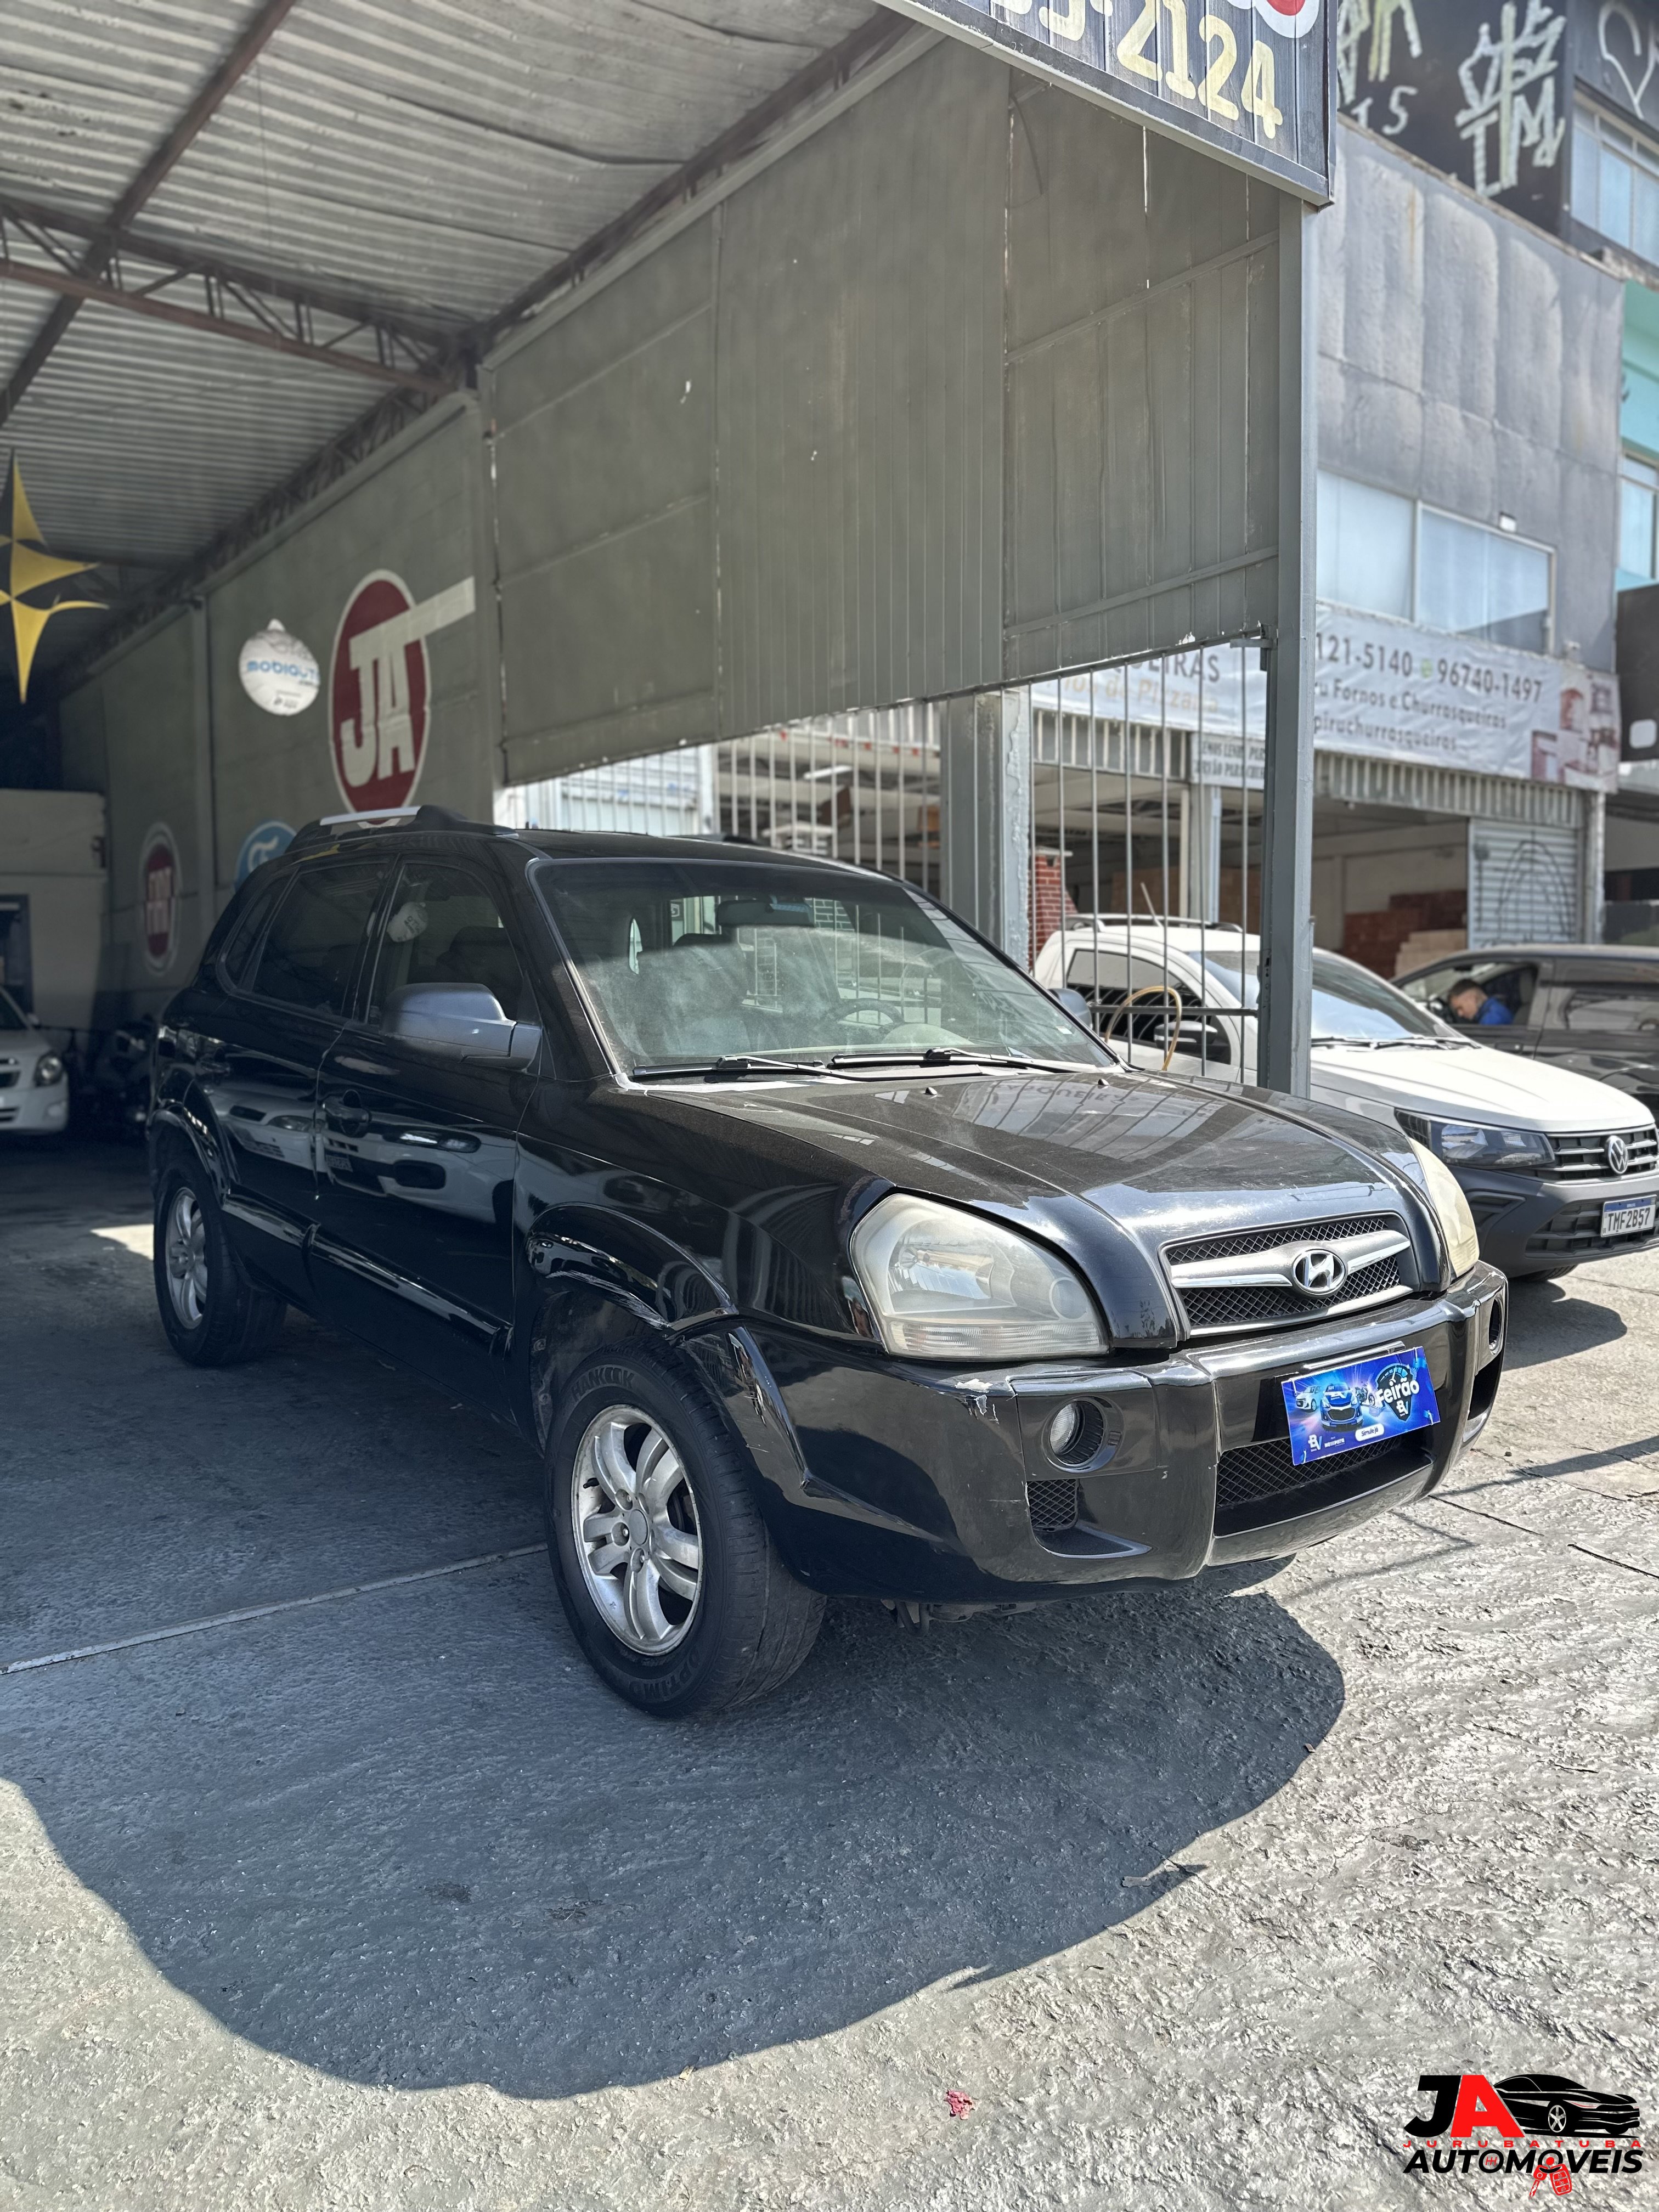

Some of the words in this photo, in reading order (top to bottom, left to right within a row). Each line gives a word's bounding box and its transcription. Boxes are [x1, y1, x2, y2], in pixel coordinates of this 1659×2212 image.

[1438, 658, 1543, 703] 96740-1497
[1334, 679, 1386, 708] Fornos
[1390, 695, 1397, 710] e
[1402, 691, 1507, 729] Churrasqueiras
[1608, 1207, 1651, 1232] TMF2B57
[1376, 1378, 1420, 1407] Feirão
